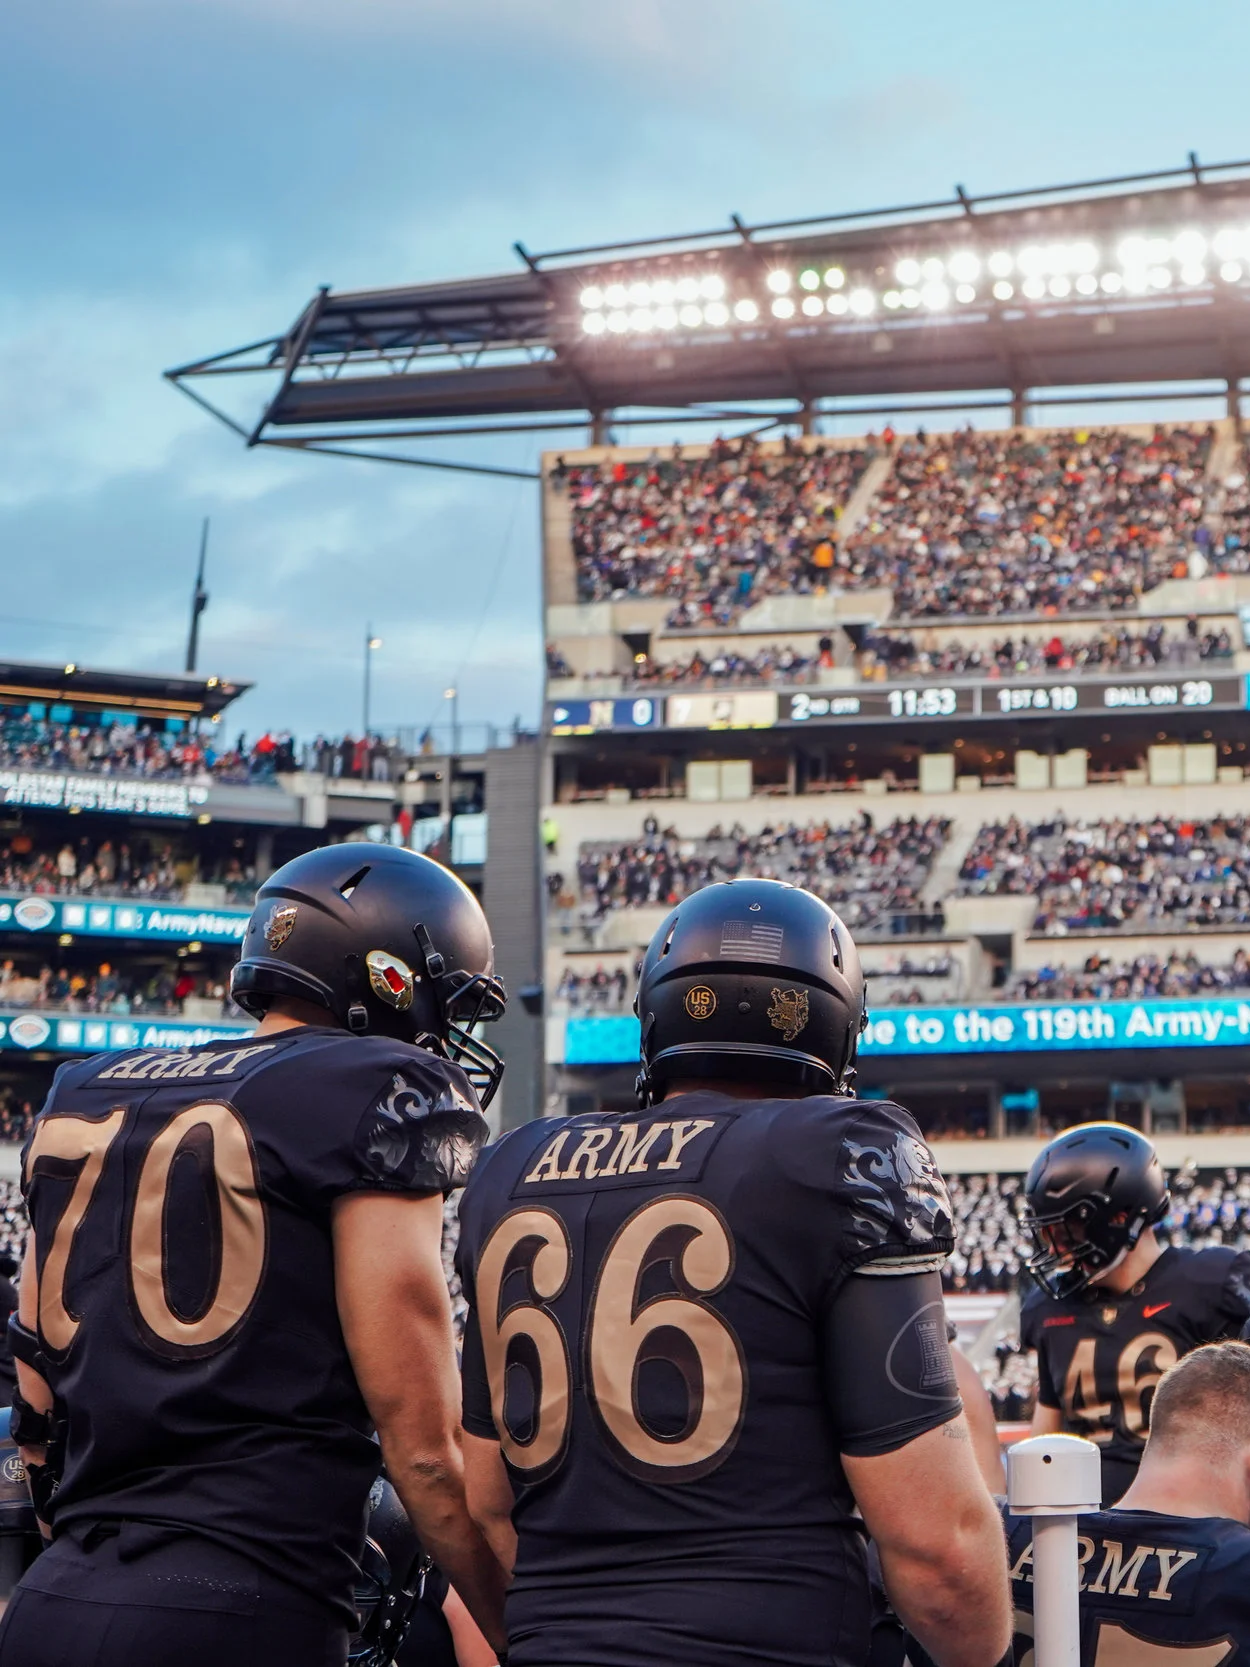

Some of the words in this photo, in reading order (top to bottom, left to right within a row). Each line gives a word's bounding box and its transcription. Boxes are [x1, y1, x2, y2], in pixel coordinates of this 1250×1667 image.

[887, 687, 957, 717] 11:53
[1149, 684, 1178, 706] ON
[632, 698, 653, 726] 0
[691, 991, 710, 1005] US
[694, 1005, 707, 1016] 28
[905, 1013, 945, 1044] to
[954, 1011, 1014, 1043] the
[1021, 1007, 1115, 1041] 119th
[98, 1044, 277, 1080] ARMY
[524, 1119, 716, 1184] ARMY
[24, 1100, 269, 1360] 70
[475, 1195, 746, 1481] 66
[1062, 1331, 1178, 1443] 46
[9, 1460, 25, 1470] US
[11, 1470, 26, 1479] 28
